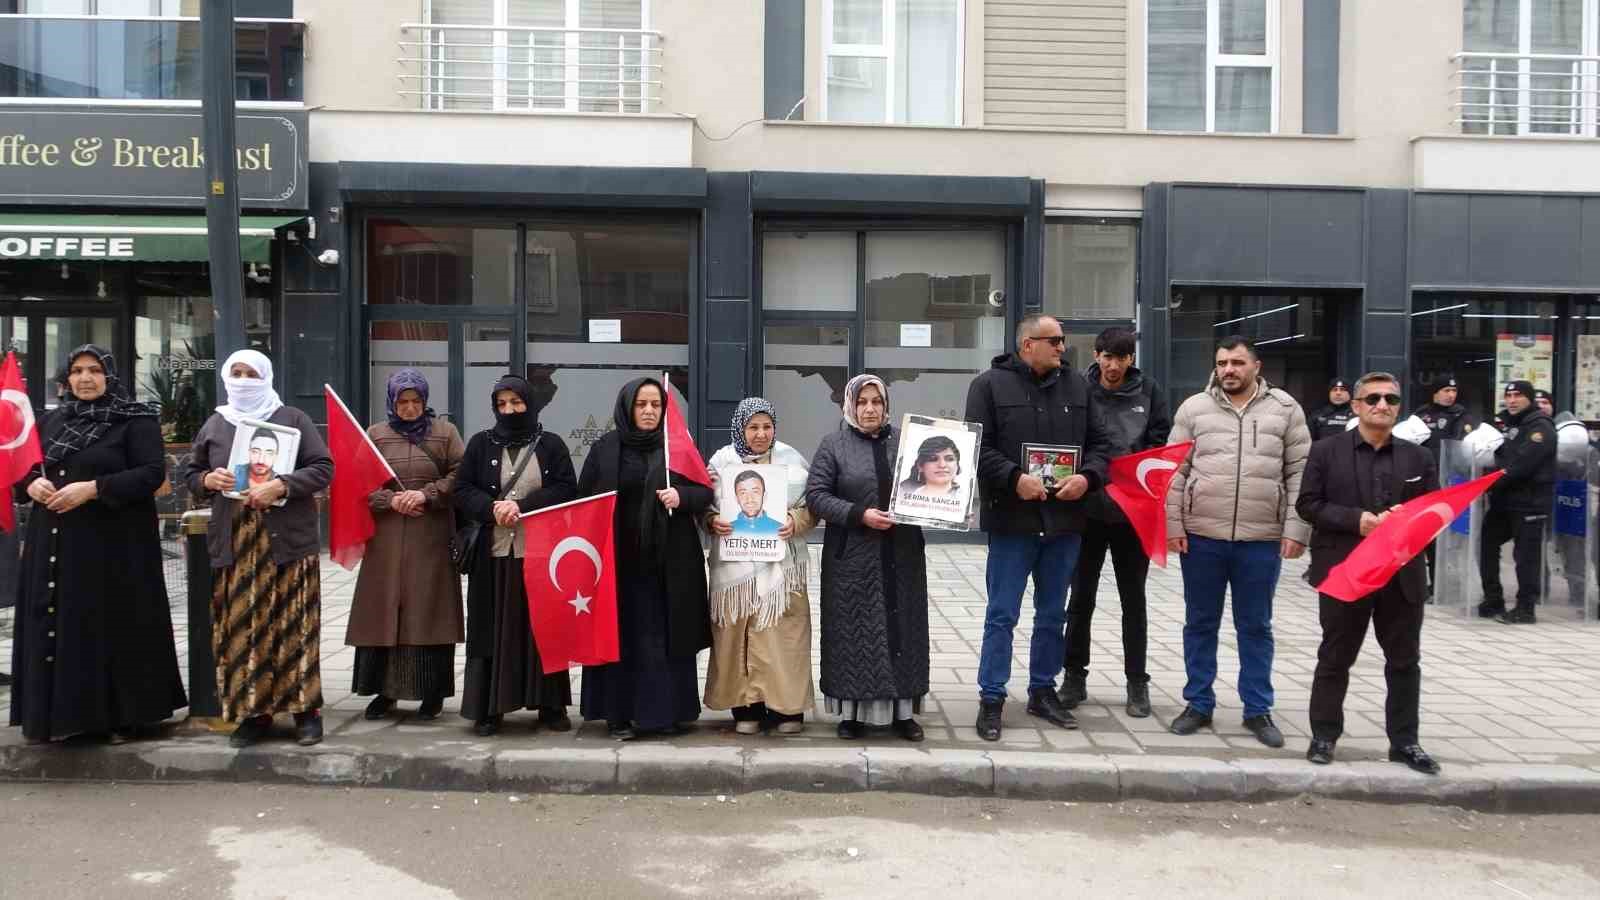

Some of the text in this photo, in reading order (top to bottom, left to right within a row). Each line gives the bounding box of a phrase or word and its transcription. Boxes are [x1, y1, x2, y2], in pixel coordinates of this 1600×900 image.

[71, 137, 103, 166] &
[112, 137, 272, 170] Breakst
[750, 539, 777, 549] MERT
